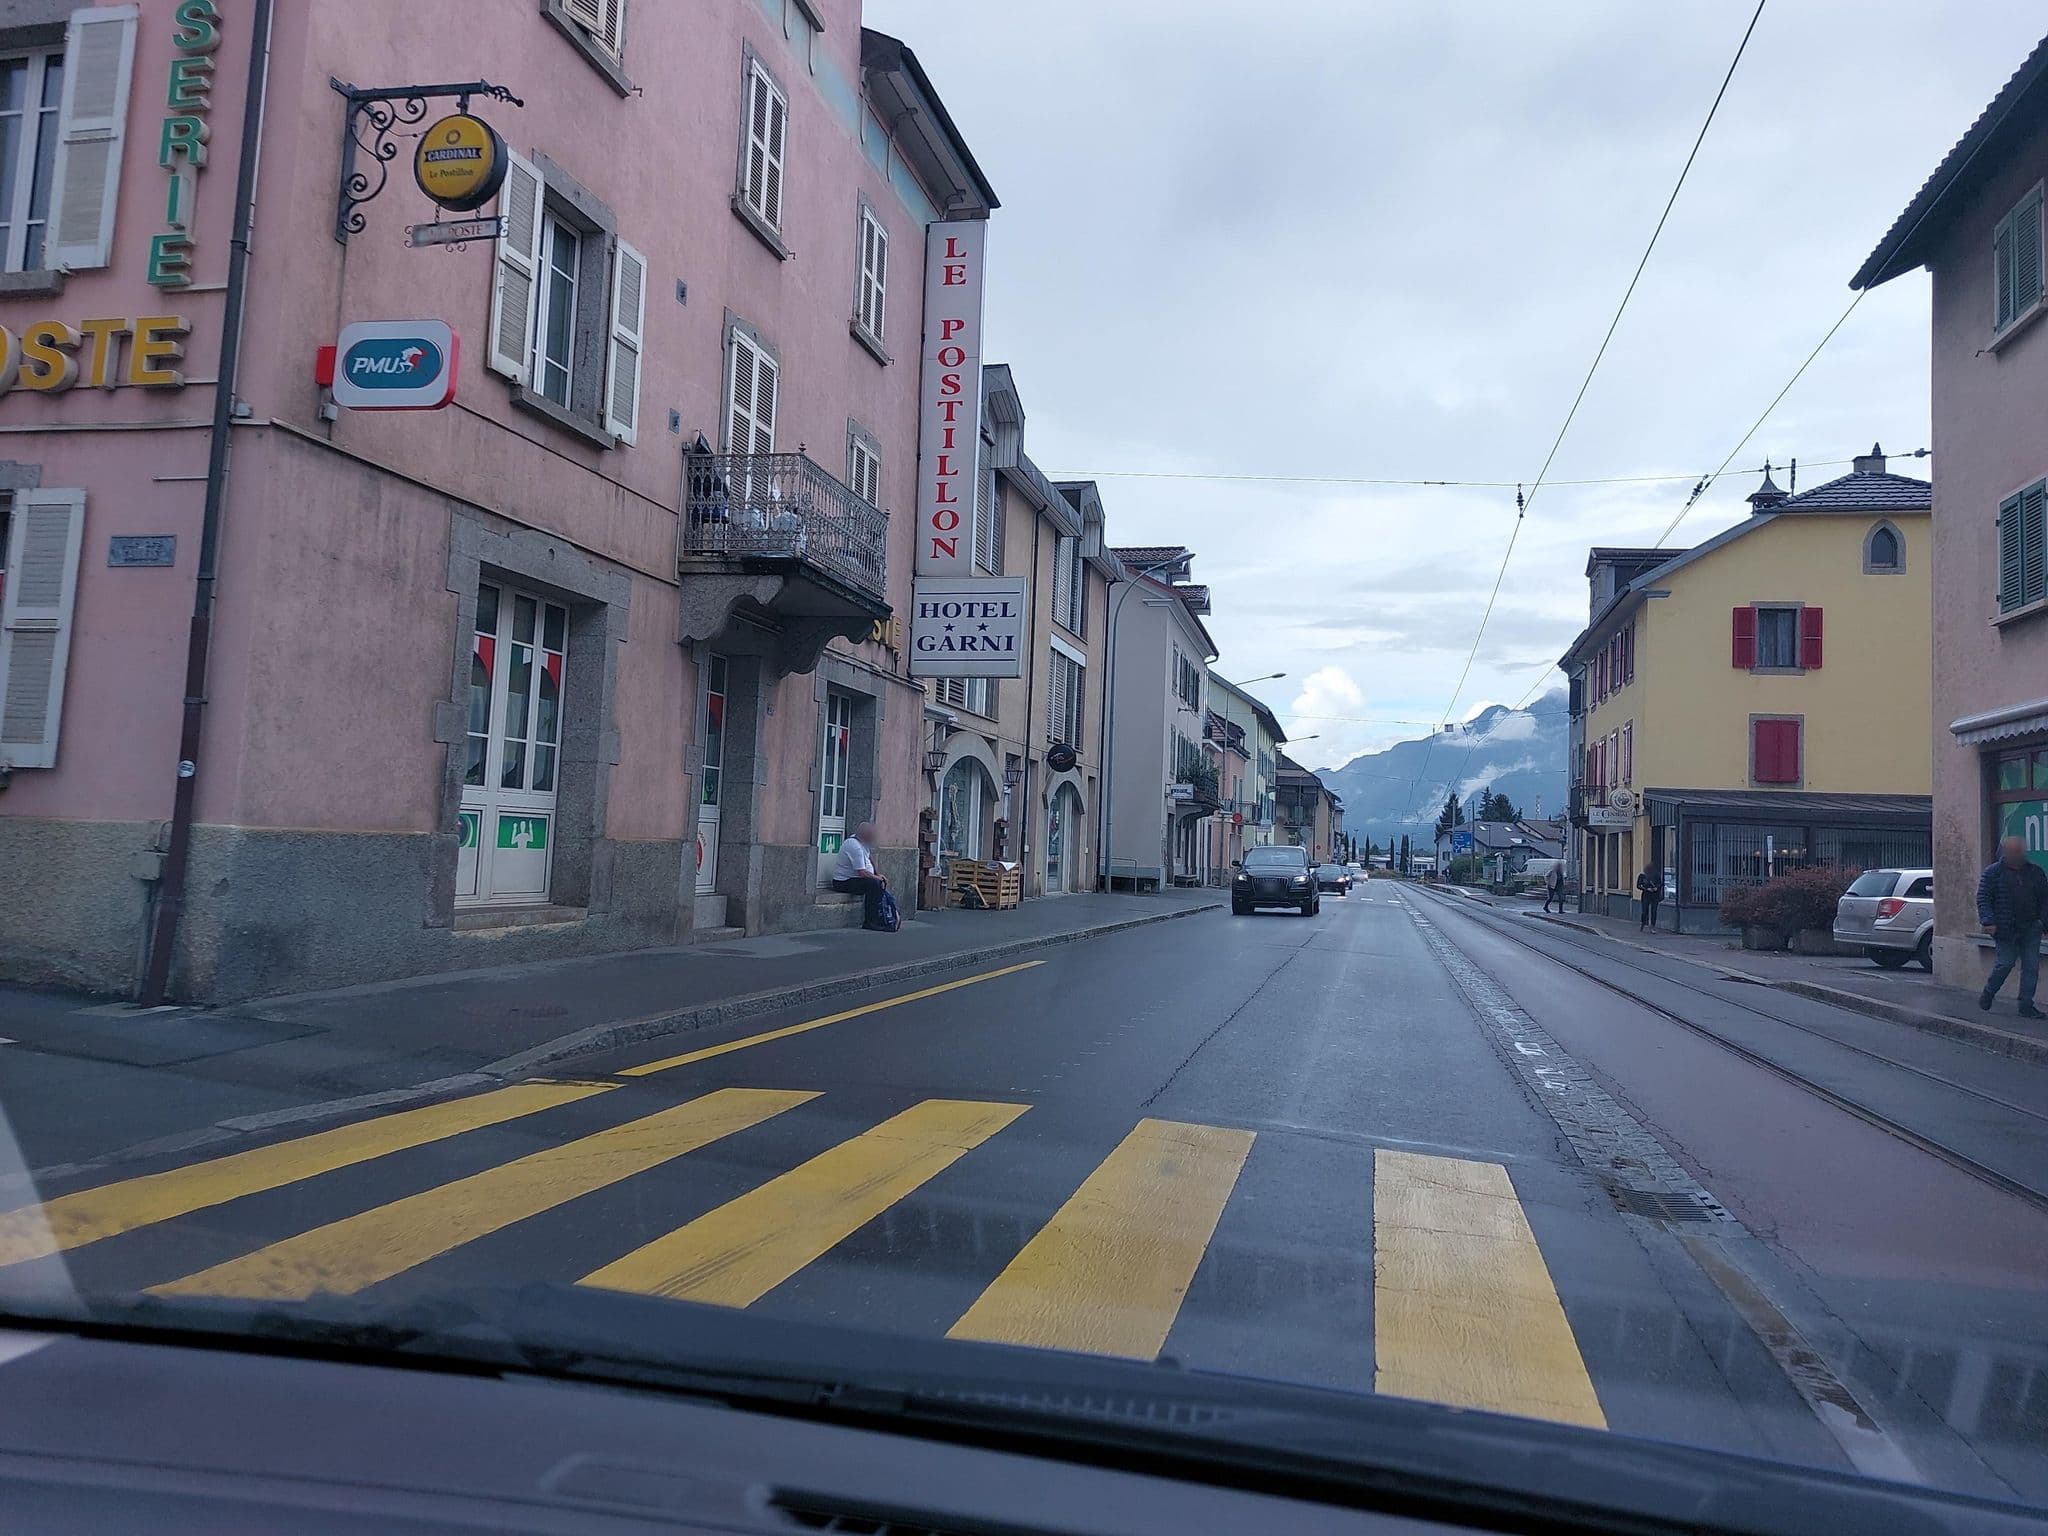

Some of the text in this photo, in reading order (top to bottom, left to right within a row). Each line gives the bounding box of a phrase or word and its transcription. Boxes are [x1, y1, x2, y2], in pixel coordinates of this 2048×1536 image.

[428, 148, 478, 161] CARDINAL
[0, 315, 190, 394] STE
[352, 356, 400, 374] PMU
[930, 236, 968, 560] LE POSTILLON
[918, 601, 1017, 619] HOTEL
[916, 635, 1014, 652] GARNI
